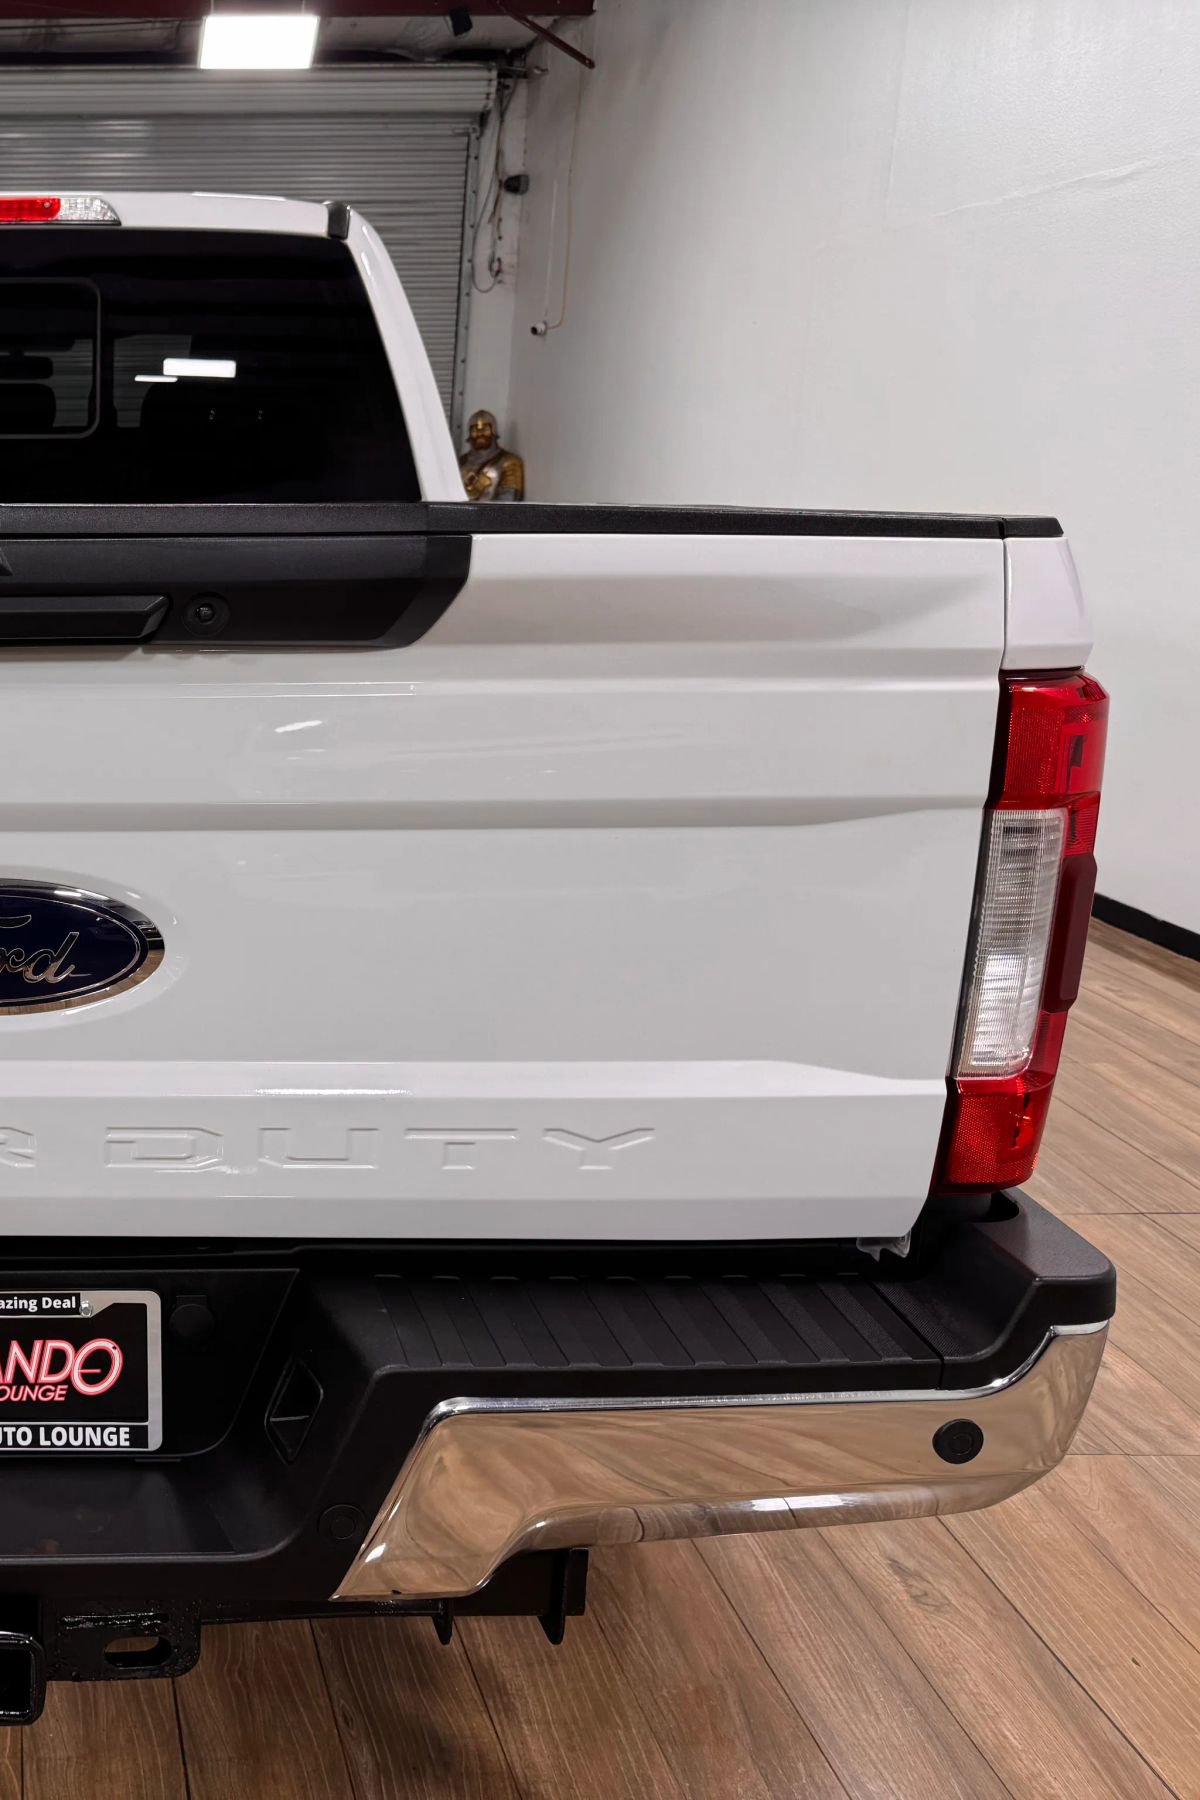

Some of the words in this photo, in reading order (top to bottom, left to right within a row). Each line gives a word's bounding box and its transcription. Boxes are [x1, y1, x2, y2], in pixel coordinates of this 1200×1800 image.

[104, 1126, 656, 1170] DUTY
[41, 1296, 77, 1310] Deal
[39, 1426, 131, 1447] LOUNGE
